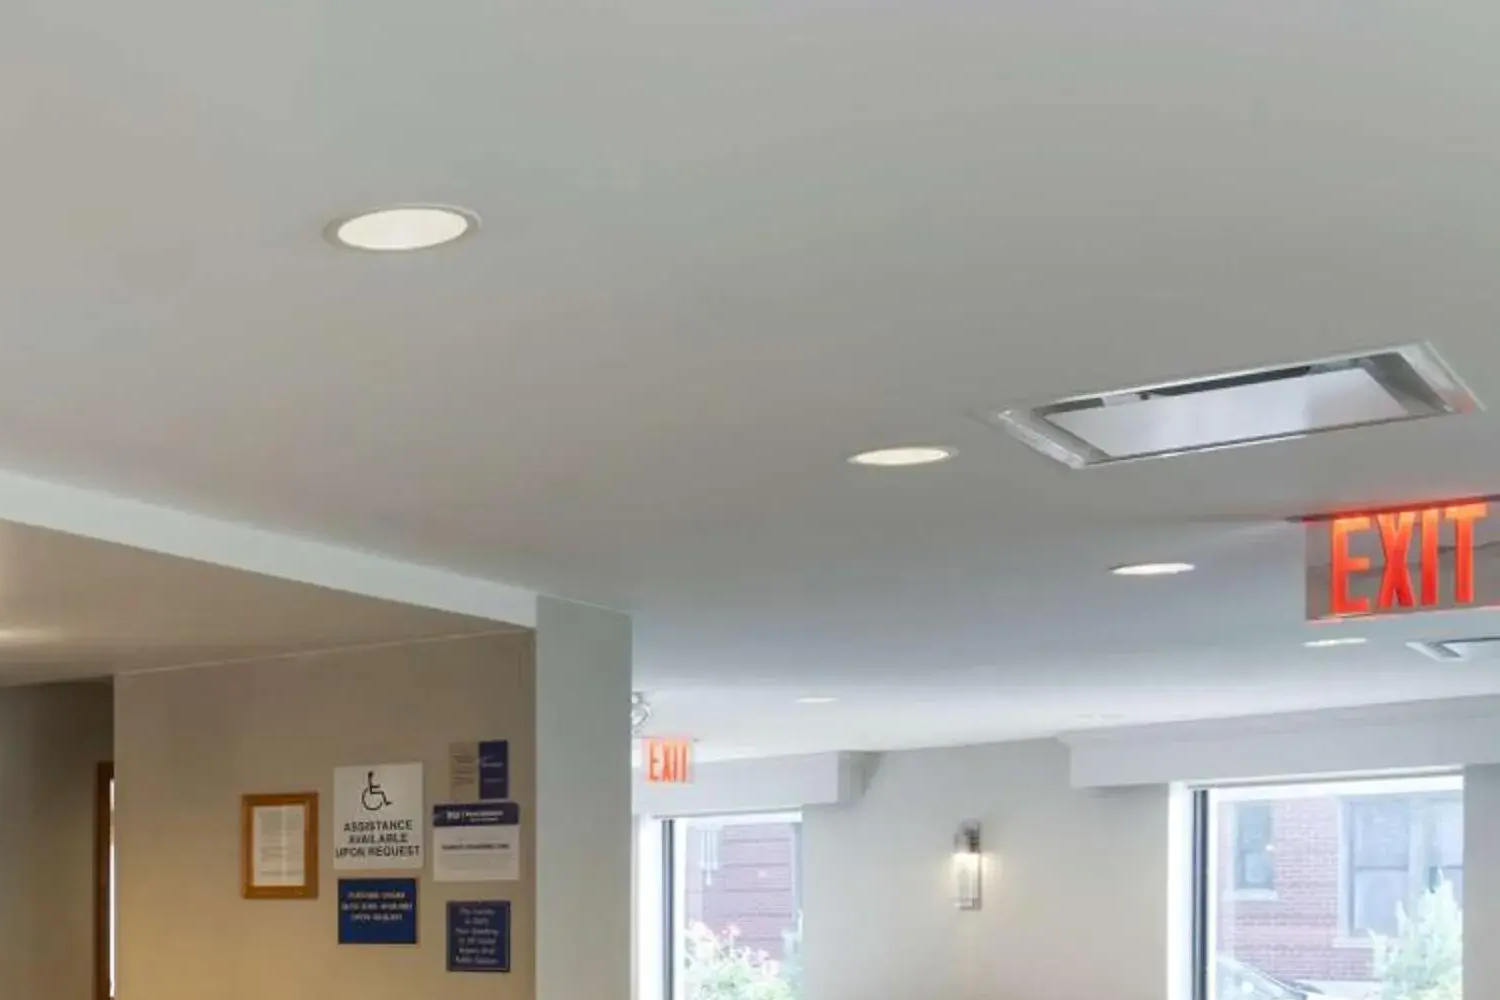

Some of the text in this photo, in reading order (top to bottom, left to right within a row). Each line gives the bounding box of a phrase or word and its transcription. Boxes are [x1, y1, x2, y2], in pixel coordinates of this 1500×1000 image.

[1331, 502, 1487, 614] EXIT
[649, 741, 689, 781] EXIT
[343, 819, 413, 832] ASSISTANCE
[348, 832, 408, 844] AVAILABLE
[335, 845, 420, 858] UPON REQUEST
